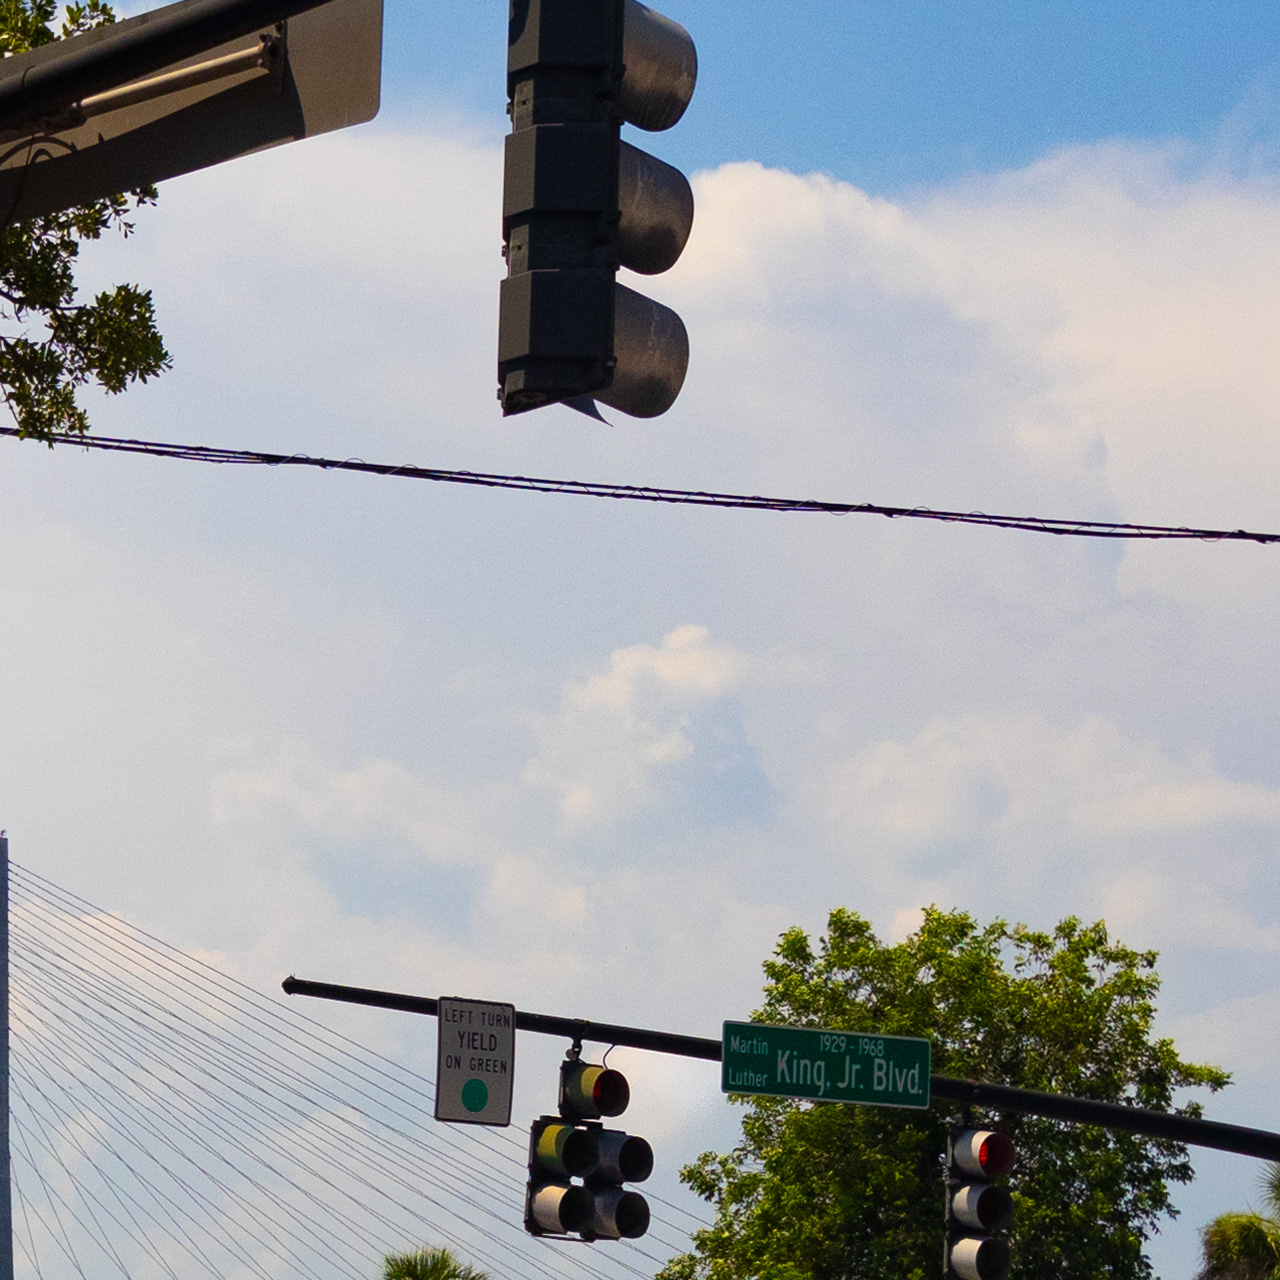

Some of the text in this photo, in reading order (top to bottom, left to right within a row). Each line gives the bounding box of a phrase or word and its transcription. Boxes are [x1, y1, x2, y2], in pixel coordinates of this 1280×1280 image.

[445, 1008, 510, 1028] LEFT TURN
[457, 1030, 498, 1052] YIELD
[730, 1035, 768, 1056] Martin
[820, 1035, 846, 1053] 1929
[858, 1038, 884, 1057] 1968
[446, 1055, 507, 1074] ON GREEN
[776, 1049, 923, 1097] King, Jr. Blvd.
[728, 1067, 768, 1088] Luther
